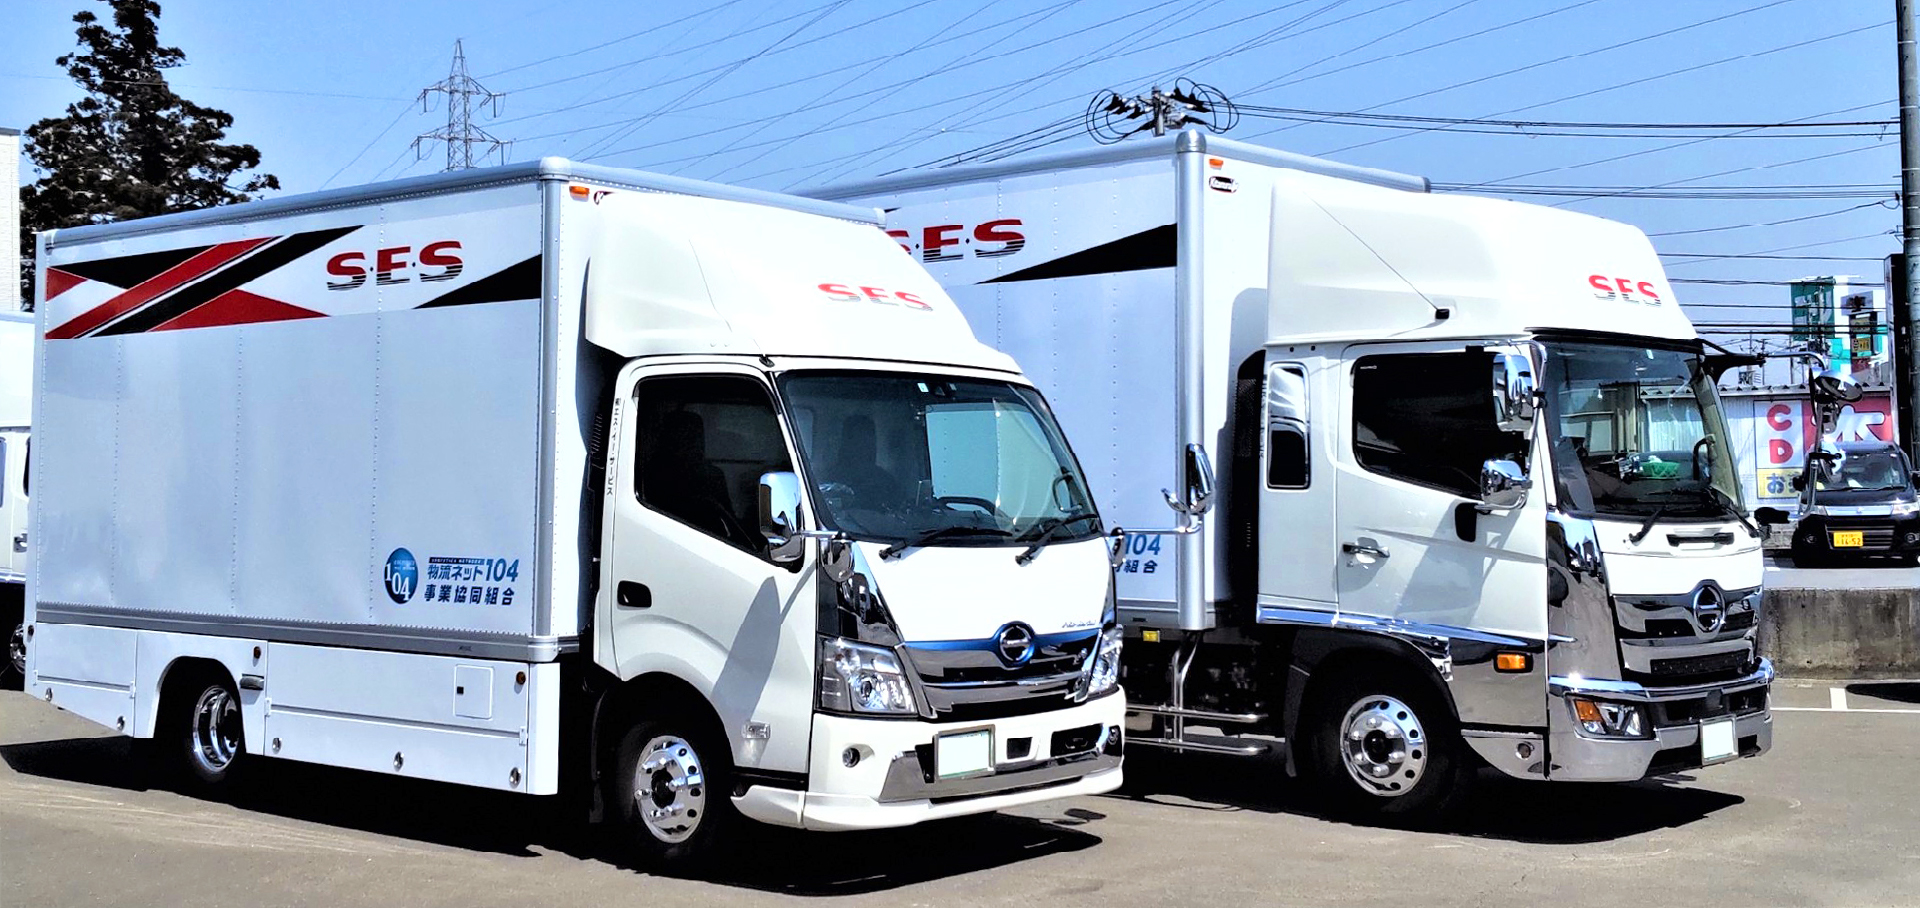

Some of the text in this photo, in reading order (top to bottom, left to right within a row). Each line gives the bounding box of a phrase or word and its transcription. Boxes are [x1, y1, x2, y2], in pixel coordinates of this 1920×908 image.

[424, 584, 515, 606] 事業協同組合
